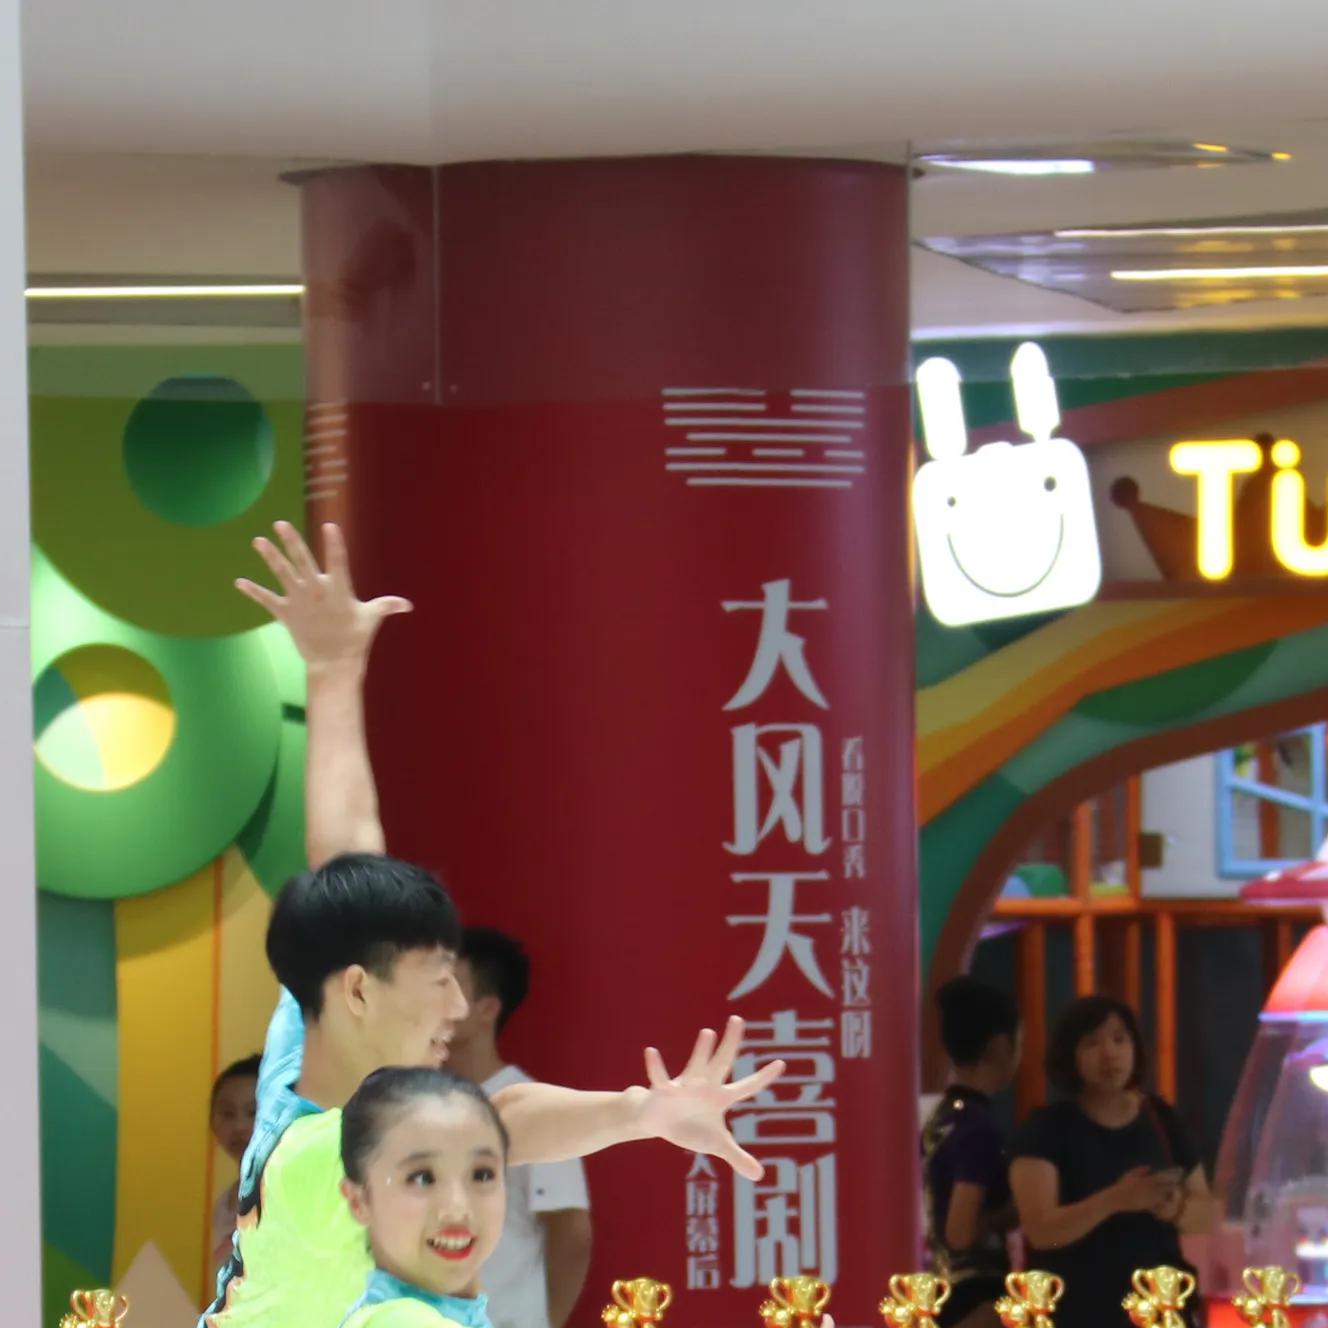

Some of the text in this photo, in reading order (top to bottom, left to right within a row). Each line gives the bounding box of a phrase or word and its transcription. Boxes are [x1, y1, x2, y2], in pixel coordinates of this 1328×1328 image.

[721, 578, 837, 1289] 大风天喜剧
